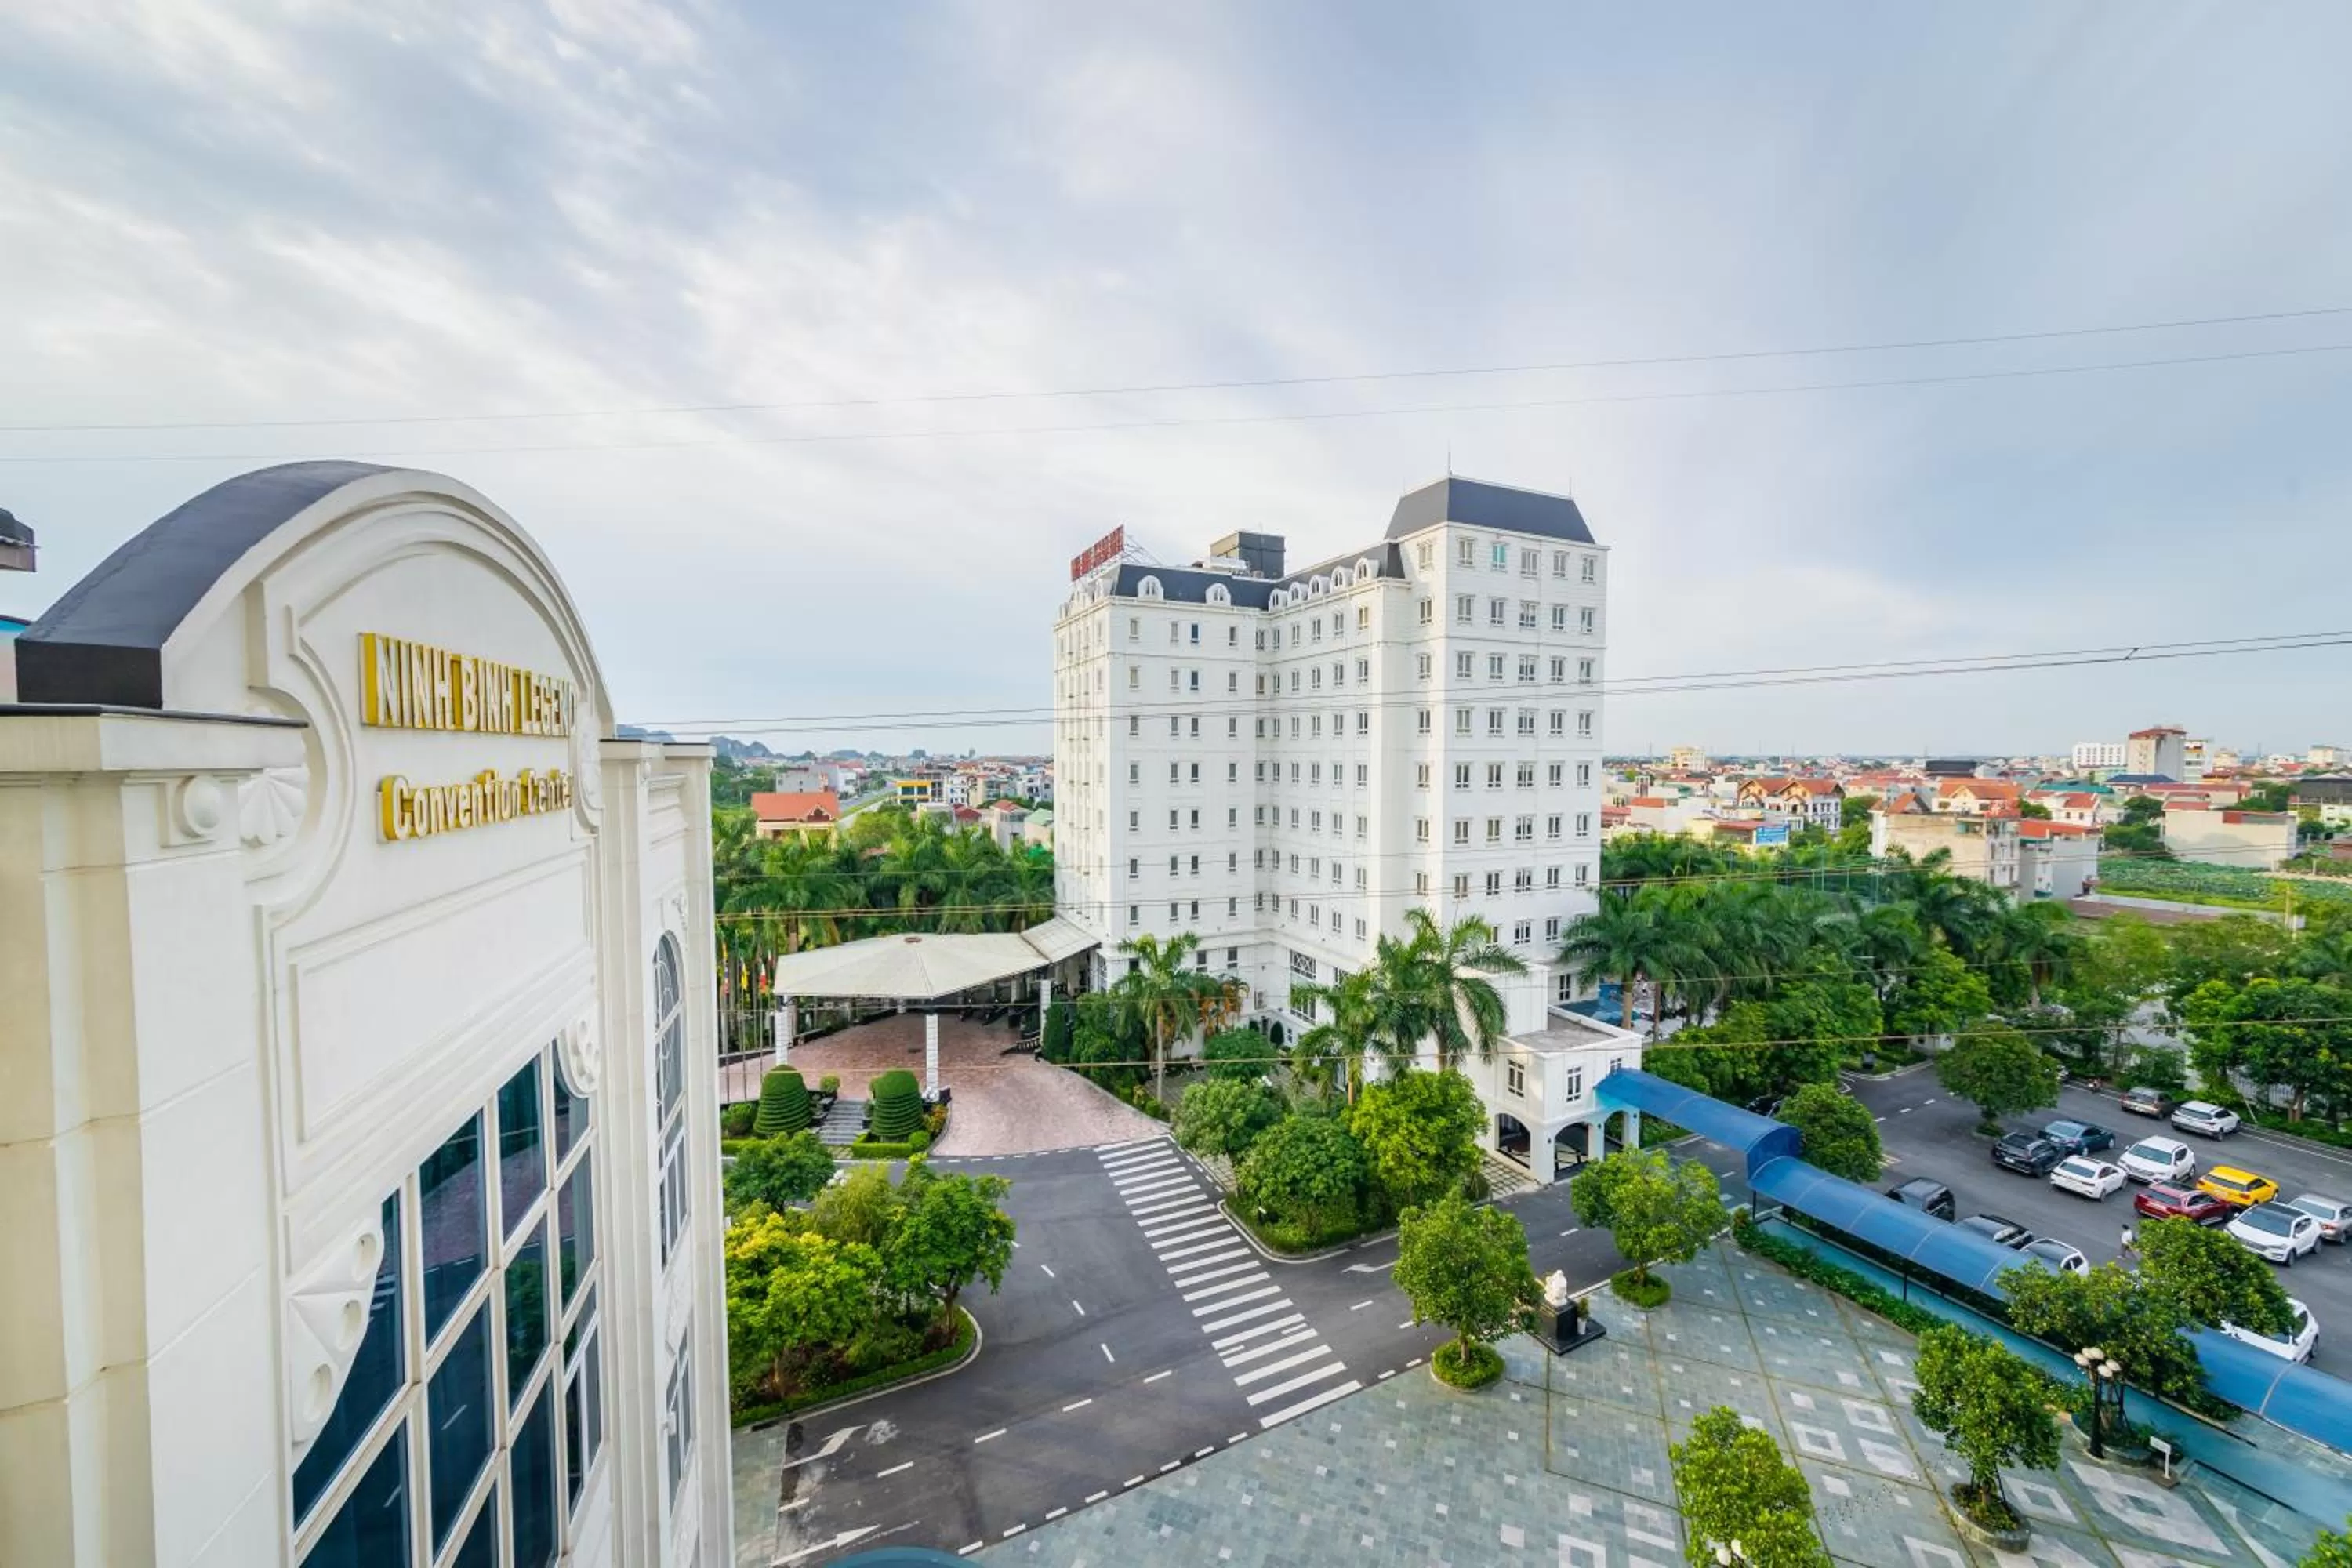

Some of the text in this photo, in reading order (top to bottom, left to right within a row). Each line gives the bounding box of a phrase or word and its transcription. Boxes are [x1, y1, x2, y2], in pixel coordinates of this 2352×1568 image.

[372, 635, 452, 728] NINH
[459, 655, 514, 733] BINH
[384, 768, 574, 840] Convention Cente
